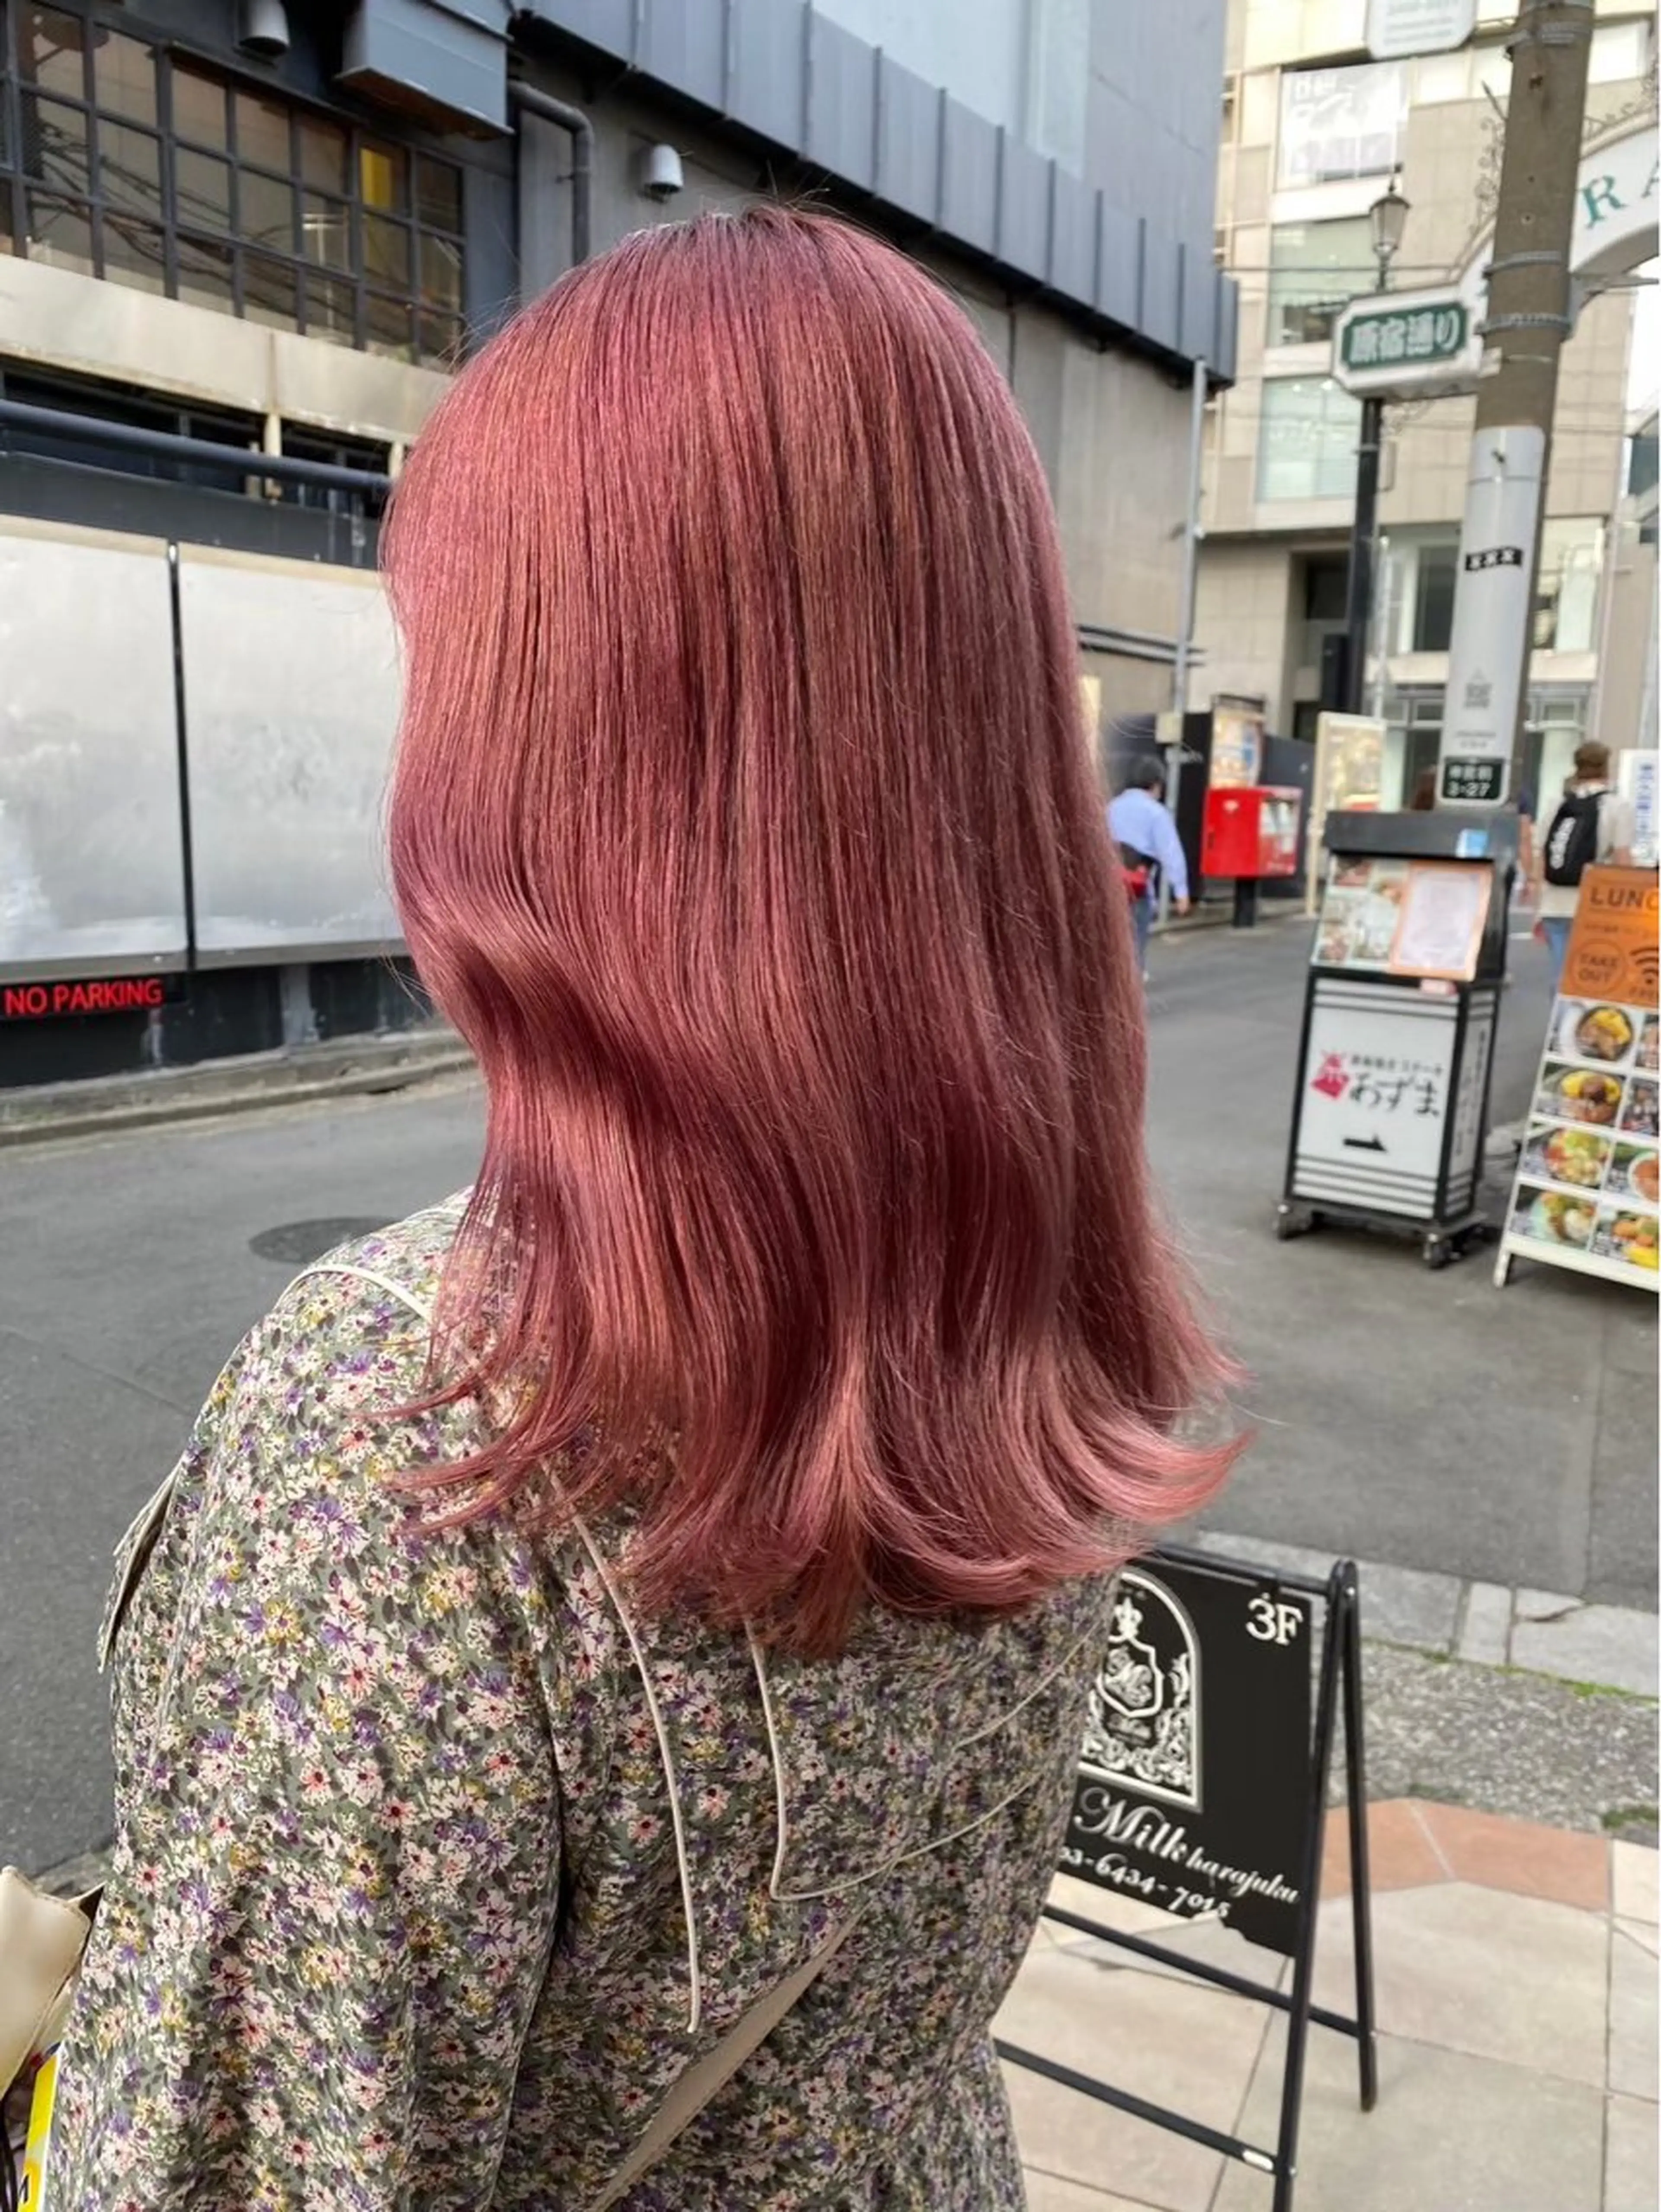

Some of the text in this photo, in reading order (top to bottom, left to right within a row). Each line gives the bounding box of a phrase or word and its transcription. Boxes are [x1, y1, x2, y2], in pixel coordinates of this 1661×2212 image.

[4, 978, 164, 1018] NO PARKING
[1246, 1597, 1304, 1646] 3F
[1073, 1786, 1300, 1905] Milk harajuku
